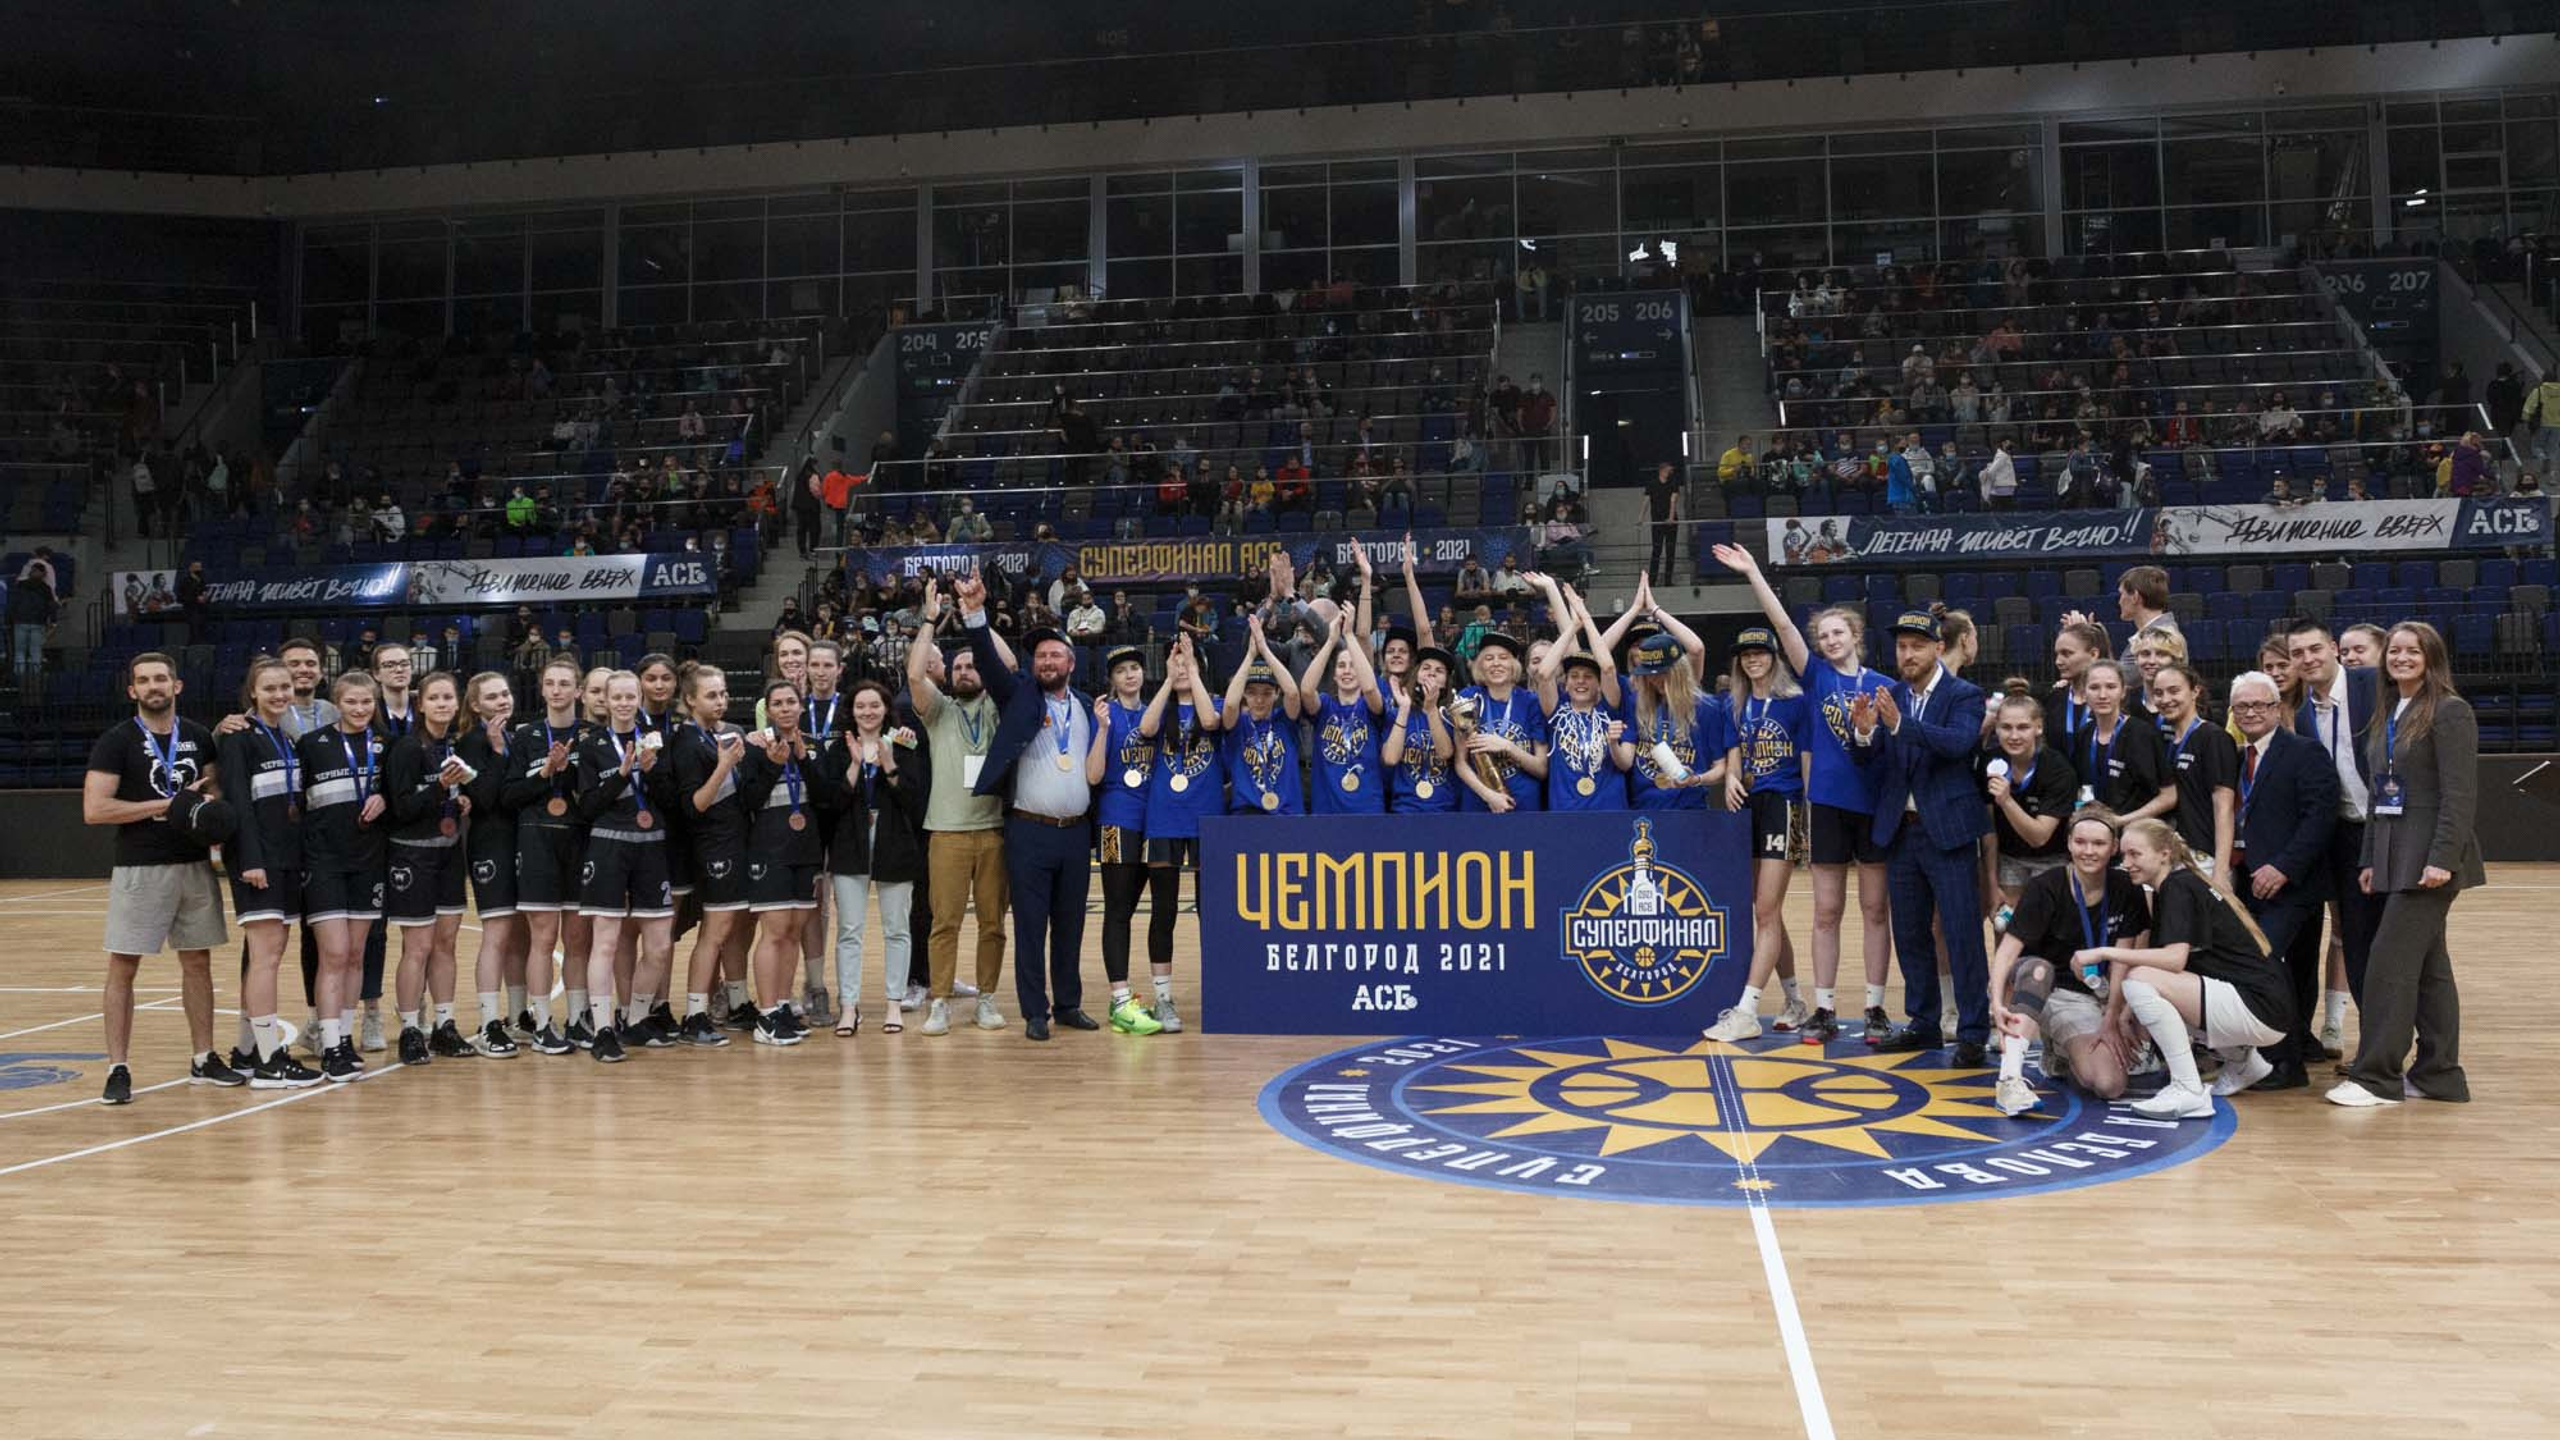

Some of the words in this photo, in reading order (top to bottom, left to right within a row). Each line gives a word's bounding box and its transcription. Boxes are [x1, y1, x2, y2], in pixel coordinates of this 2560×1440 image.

[2388, 270, 2432, 293] 207
[1580, 303, 1620, 323] 205
[1634, 301, 1674, 321] 206
[901, 332, 938, 352] 204
[2467, 507, 2540, 535] АСБ
[997, 553, 1030, 574] 2021
[1079, 542, 1232, 577] СУПЕРФИНАЛ
[1436, 539, 1471, 561] 2021
[653, 561, 708, 588] АСБ
[1765, 833, 1786, 851] 14
[1235, 849, 1536, 931] ЧЕМПИОН
[1573, 918, 1718, 948] СУПЕРФИНАЛ
[1265, 943, 1420, 975] БЕЛГОРОД
[1439, 943, 1506, 971] 2021
[1614, 961, 1678, 981] БЕЛГОРОД
[1351, 984, 1419, 1012] АСБ
[1303, 1083, 1607, 1186] СУПЕРФИНАЛ
[1882, 1130, 2159, 1191] БЕЛОВА
